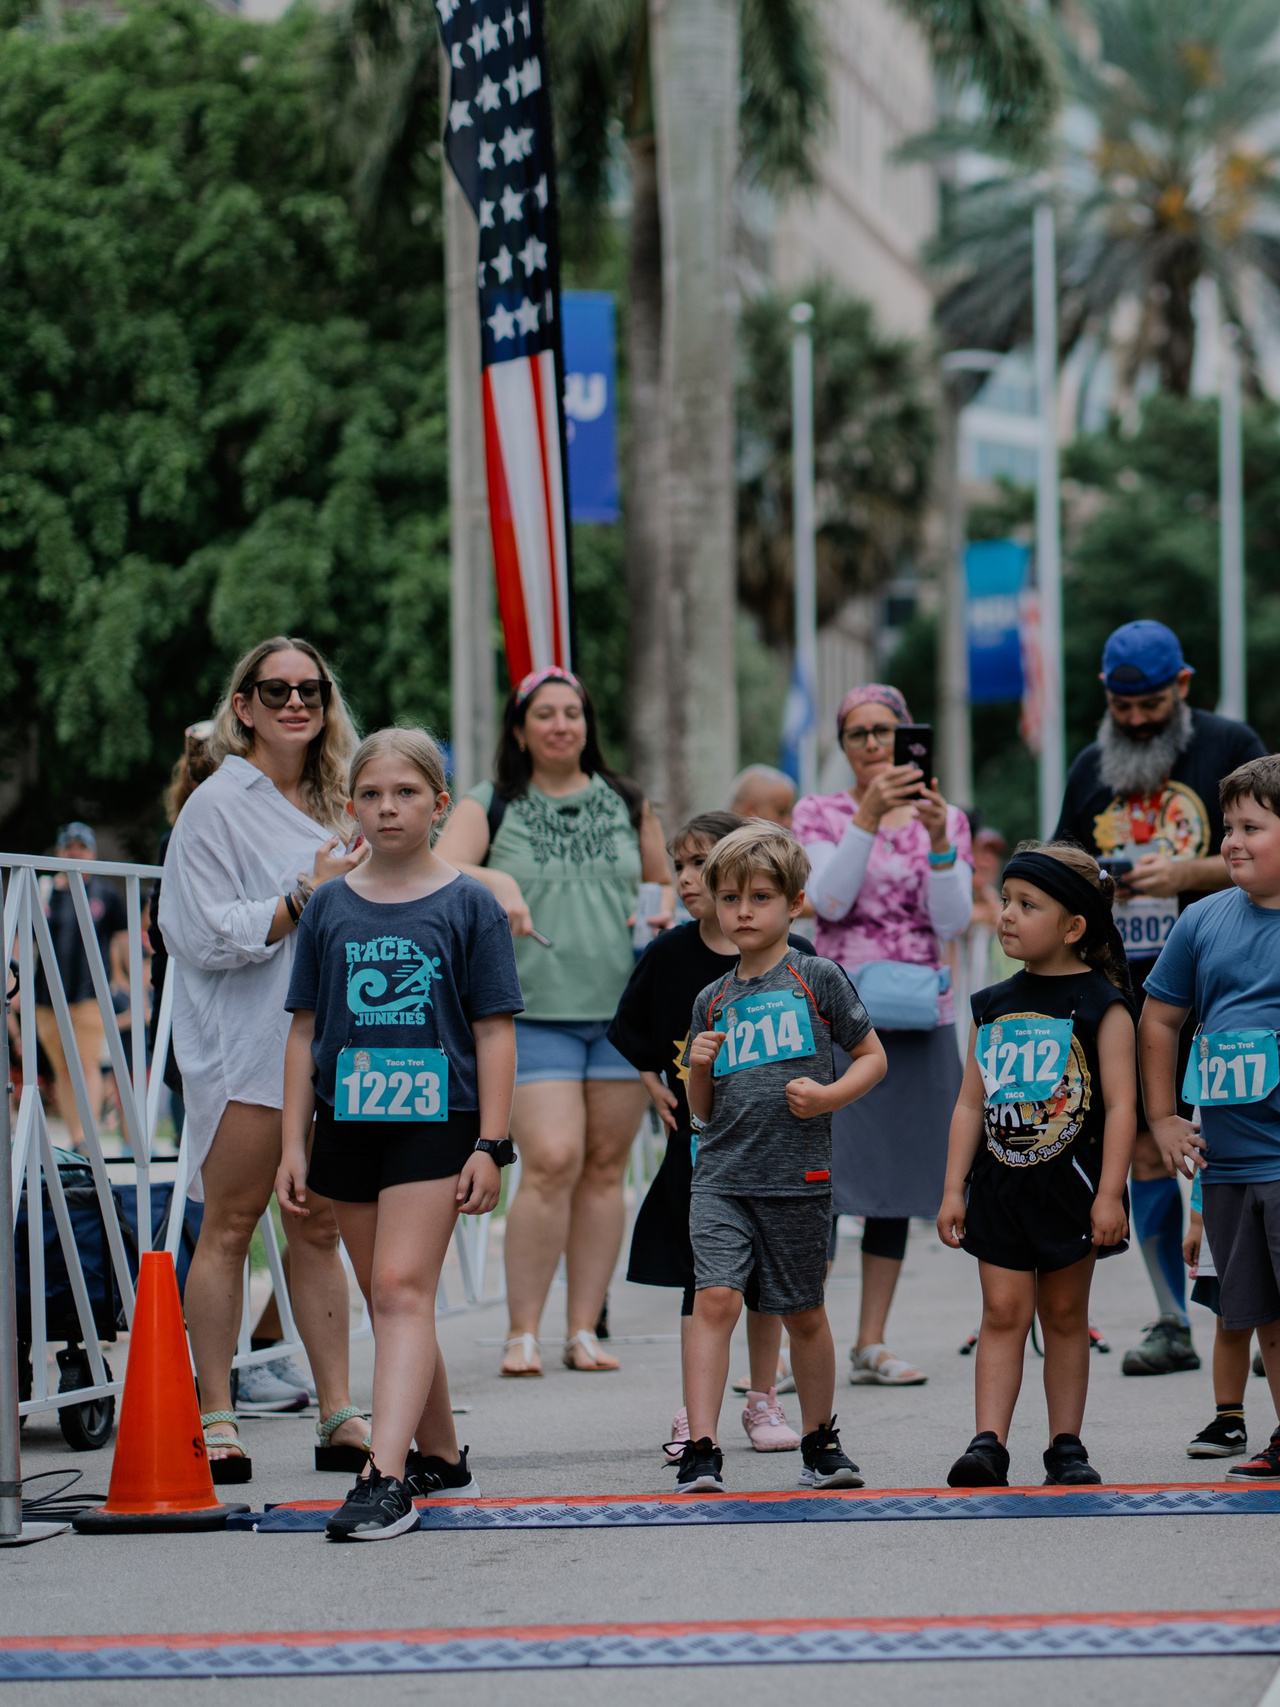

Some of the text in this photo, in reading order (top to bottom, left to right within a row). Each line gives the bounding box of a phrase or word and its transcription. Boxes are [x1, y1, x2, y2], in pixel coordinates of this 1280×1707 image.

[1116, 915, 1175, 943] 3802
[345, 940, 412, 963] RACE
[355, 1011, 426, 1027] JUNKIES
[746, 1000, 784, 1013] Taco Trot
[724, 1010, 804, 1068] 1214
[1218, 1041, 1255, 1051] Taco Trot
[385, 1059, 425, 1067] Taco Trot
[983, 1039, 1061, 1084] 1212
[1198, 1053, 1266, 1100] 1217
[342, 1071, 441, 1116] 1223
[1004, 1091, 1025, 1100] TACO
[1005, 1149, 1028, 1165] Mile
[1028, 1150, 1037, 1162] &
[1039, 1142, 1063, 1159] Taco
[1060, 1121, 1080, 1141] Trot
